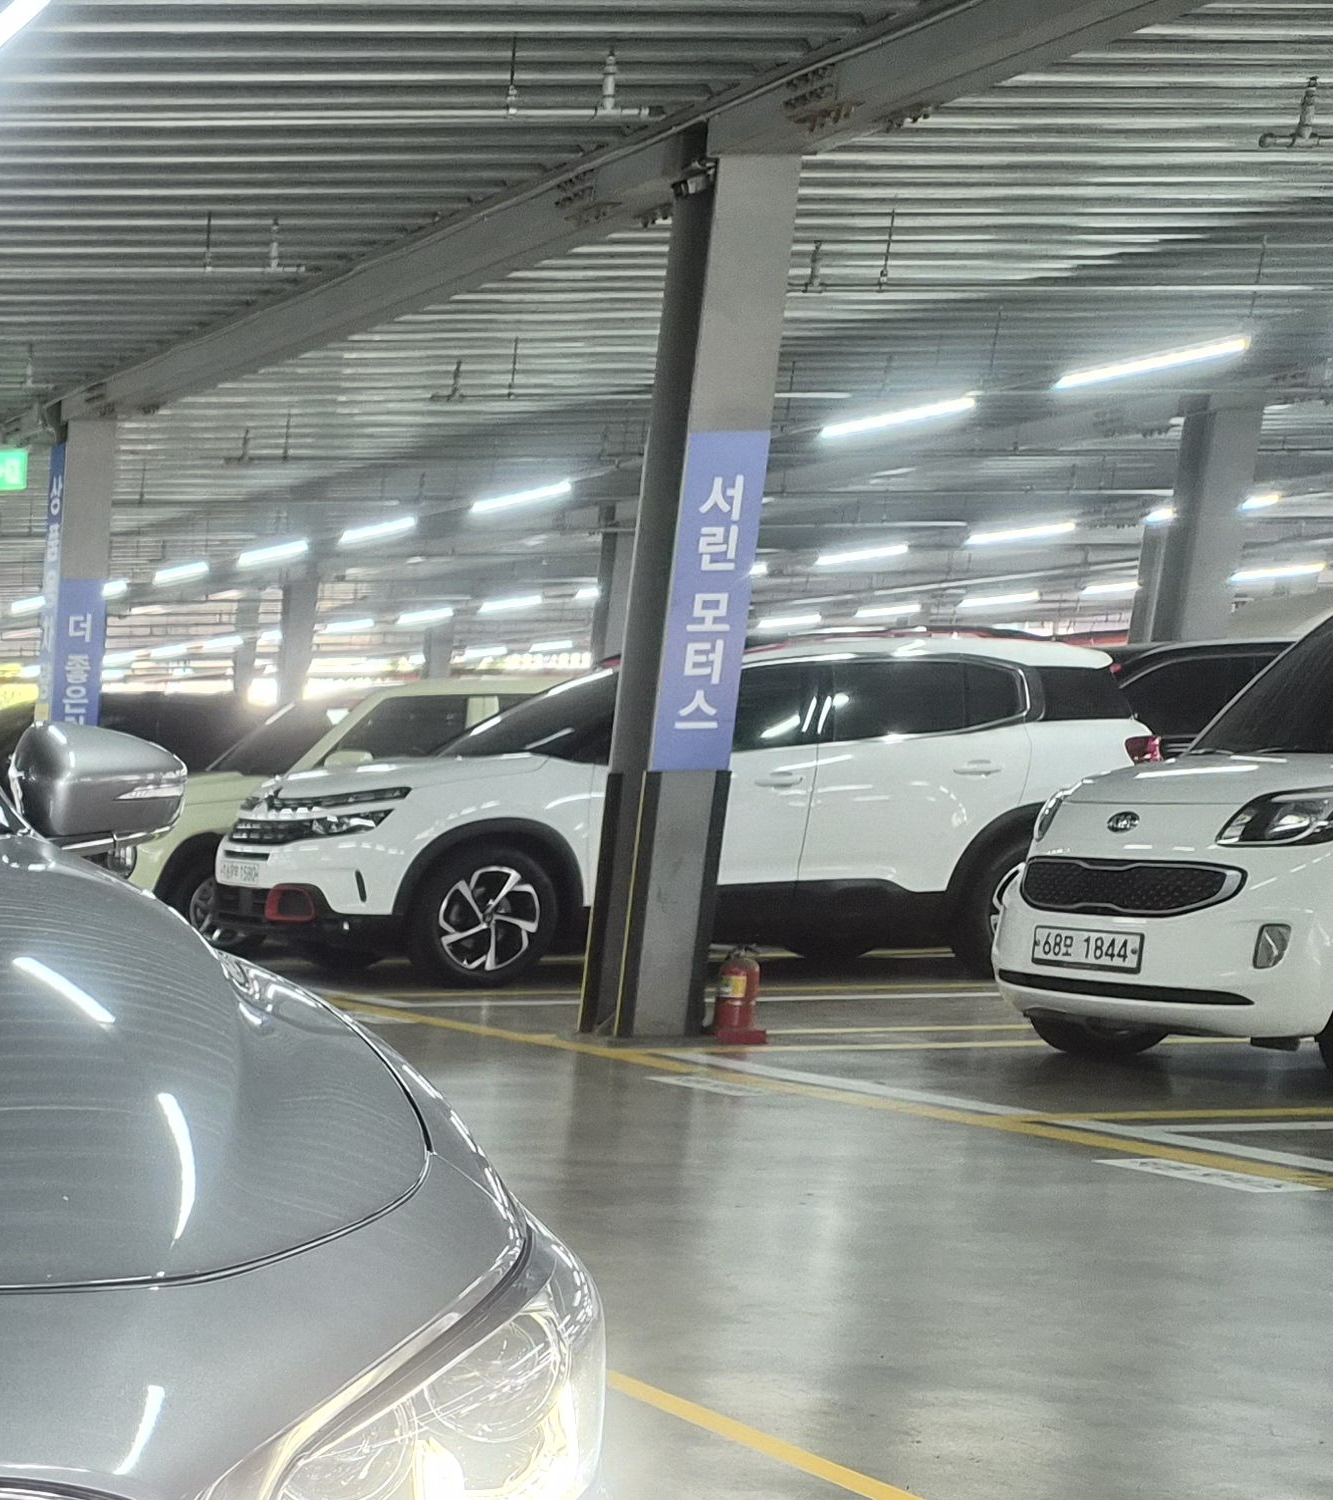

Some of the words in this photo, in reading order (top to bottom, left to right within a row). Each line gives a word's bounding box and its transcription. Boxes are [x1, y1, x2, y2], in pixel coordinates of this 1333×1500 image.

[698, 475, 744, 572] 서린
[674, 593, 731, 731] 모터스
[1042, 931, 1074, 957] 68모
[1083, 935, 1129, 963] 1844
